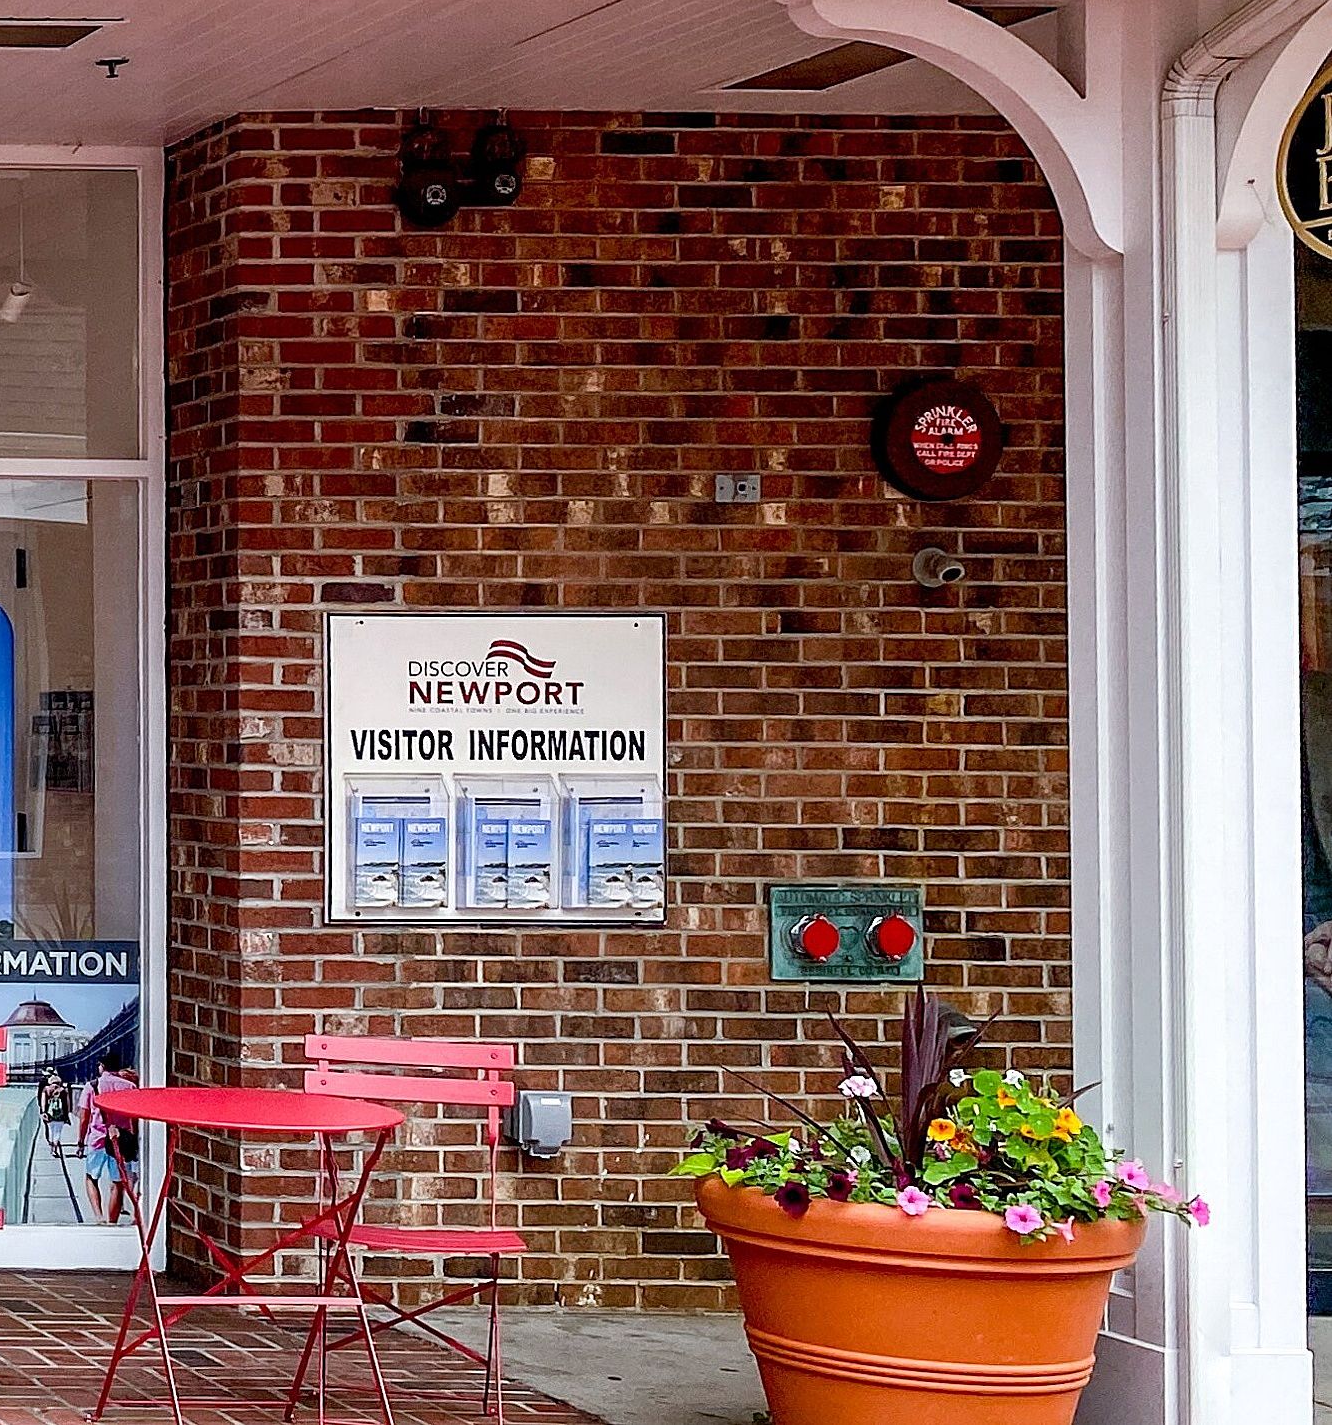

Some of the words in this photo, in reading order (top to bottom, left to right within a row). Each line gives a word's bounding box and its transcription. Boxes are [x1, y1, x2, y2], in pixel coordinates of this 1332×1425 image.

[915, 405, 978, 433] SPRINKLER
[936, 418, 956, 426] FIRE
[928, 427, 963, 435] ALARM
[409, 661, 508, 677] DISCOVER
[408, 681, 584, 706] NEWPORT
[350, 729, 454, 761] VISITOR
[469, 729, 645, 762] INFORMATION
